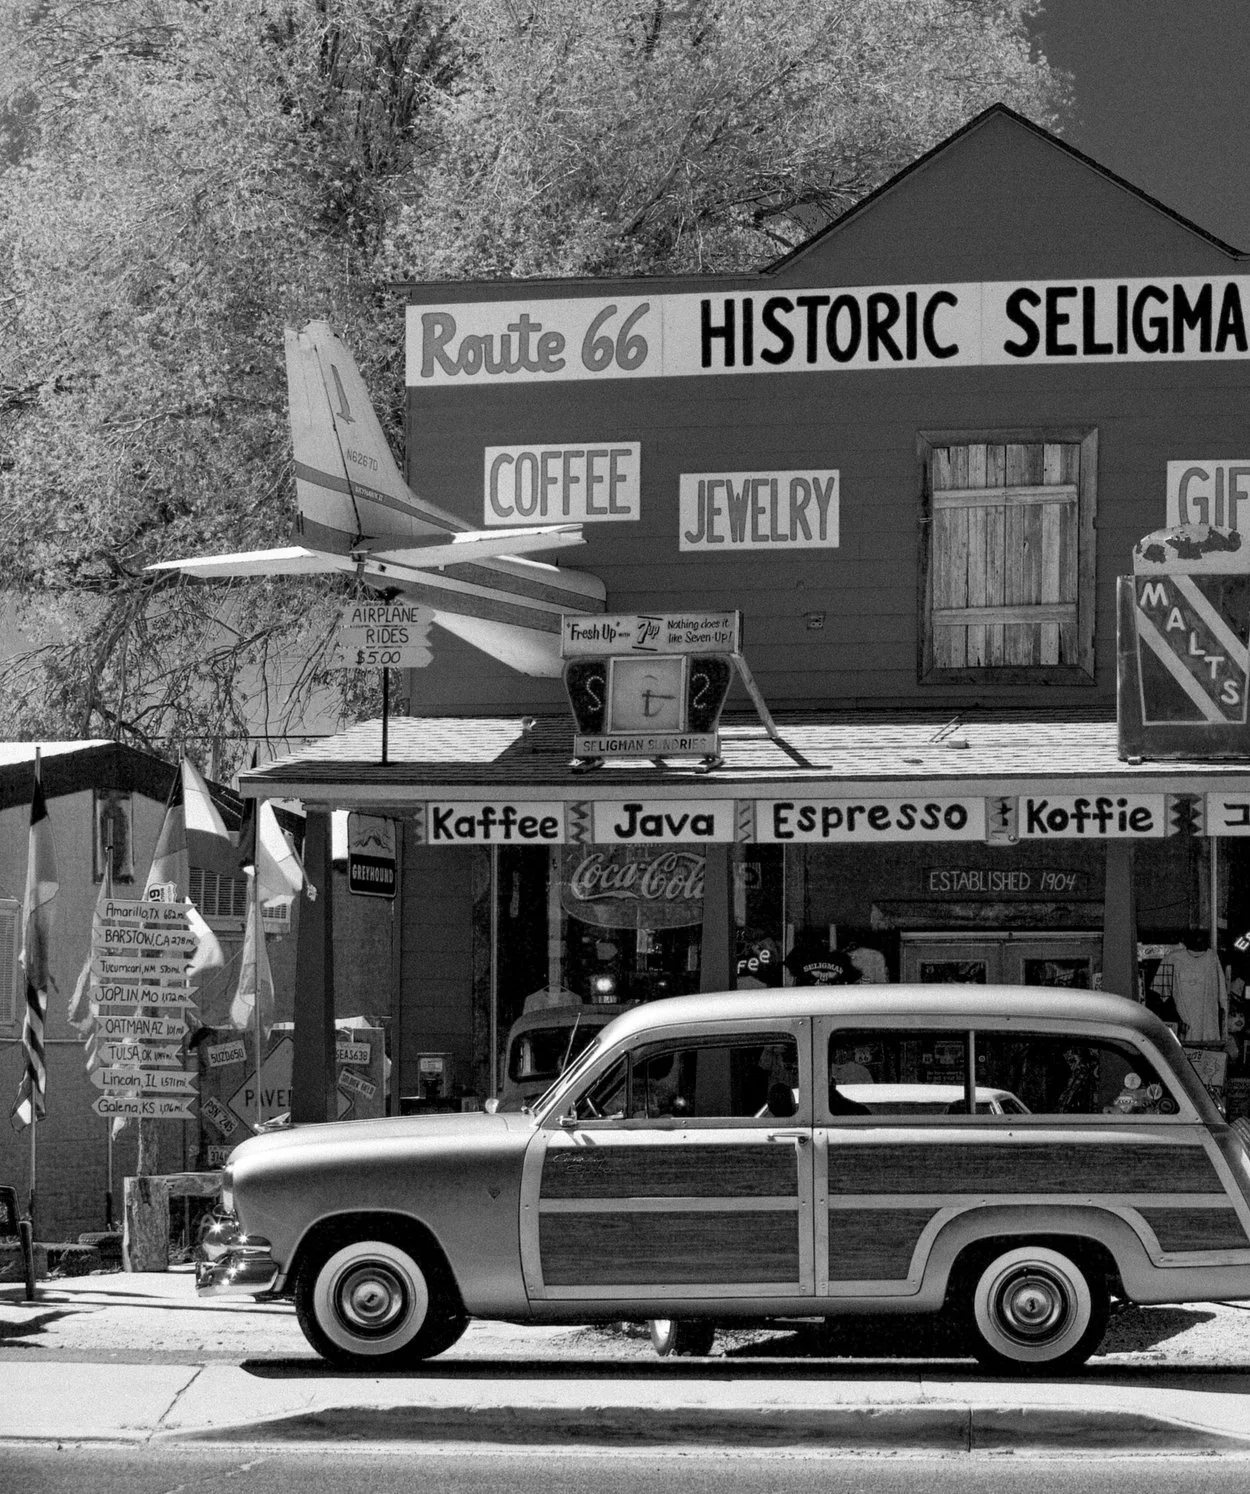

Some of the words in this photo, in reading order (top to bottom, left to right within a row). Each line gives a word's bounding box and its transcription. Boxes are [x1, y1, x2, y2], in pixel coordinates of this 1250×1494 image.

[421, 312, 566, 377] Route
[581, 303, 650, 371] 66
[700, 291, 959, 368] HISTORIC
[489, 449, 632, 517] COFFEE
[685, 477, 835, 544] JEWELRY
[352, 607, 419, 623] AIRPLANE
[667, 619, 699, 631] Nothing
[701, 618, 720, 629] does
[722, 618, 728, 628] it
[366, 628, 409, 643] RIDES
[668, 633, 682, 643] like
[1140, 582, 1240, 705] MALTS
[583, 739, 643, 751] SELIGMAN
[433, 806, 558, 840] Kaffee
[614, 803, 715, 838] Java
[773, 801, 967, 836] Espresso
[1027, 798, 1154, 835] Koffie
[352, 864, 393, 883] GREYHOUND
[929, 871, 1030, 891] ESTABLISHED
[1040, 872, 1077, 891] 1904
[245, 1089, 291, 1107] PAVE
[219, 1116, 234, 1133] 245
